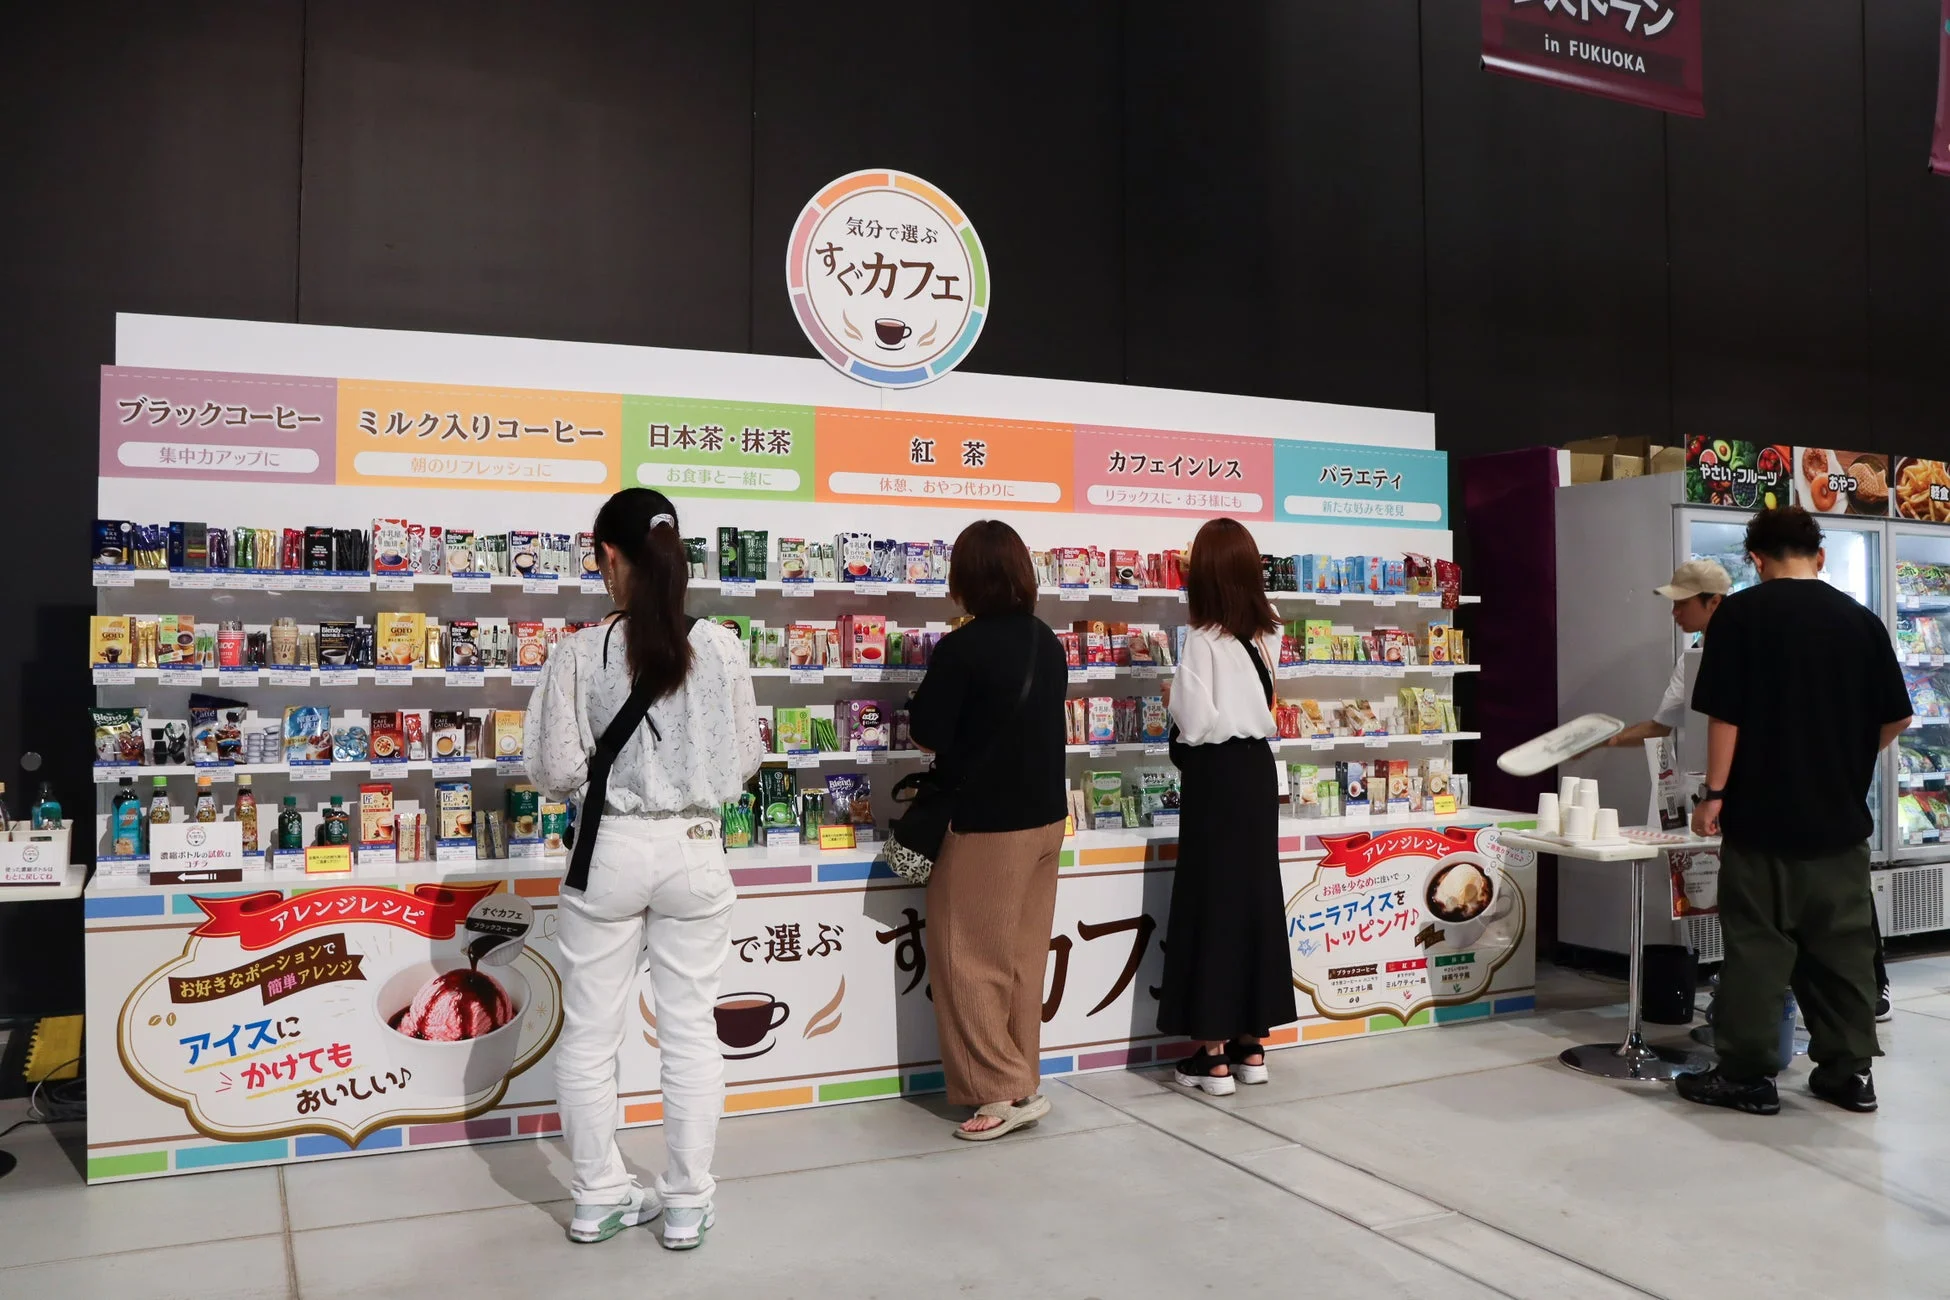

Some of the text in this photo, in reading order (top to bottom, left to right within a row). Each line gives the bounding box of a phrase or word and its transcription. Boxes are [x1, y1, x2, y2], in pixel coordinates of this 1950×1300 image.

[1514, 0, 1674, 36] トラン
[1545, 34, 1646, 73] in FUKUOKA
[846, 216, 939, 244] 気分で選ぶ
[815, 241, 964, 301] すぐカフェ
[117, 396, 322, 431] ブラックコーヒー
[358, 408, 604, 443] ミルク入りコーヒー
[649, 423, 791, 455] 日本茶・抹茶
[159, 446, 281, 468] 集中力アップに
[411, 456, 552, 478] 朝のリフレッシュに
[1108, 451, 1243, 480] カフェインレス
[666, 467, 772, 487] お食事と一緒に
[879, 477, 1015, 498] 休憩、おやつ代わりに
[1319, 465, 1403, 490] バラエティ
[1700, 463, 1778, 486] やさい・フルーツ
[1828, 474, 1858, 493] おやつ
[1106, 489, 1243, 509] リラックスに・お子様にも
[1321, 500, 1404, 517] 新たな好みを発見
[92, 713, 128, 722] Blendy
[1362, 835, 1450, 863] アレンジレシピ
[185, 859, 208, 868] コチラ
[269, 896, 425, 932] アレンジレシピ
[474, 922, 518, 933] ブラックコーヒー
[482, 907, 524, 920] すぐカフェ
[1289, 890, 1406, 937] バニラアイスを
[179, 940, 337, 999] お好きなポーションで
[267, 959, 354, 997] 簡単アレンジ
[1336, 966, 1376, 977] ブラックコーヒー
[179, 1015, 302, 1065] アイスに
[240, 1043, 353, 1090] かけても
